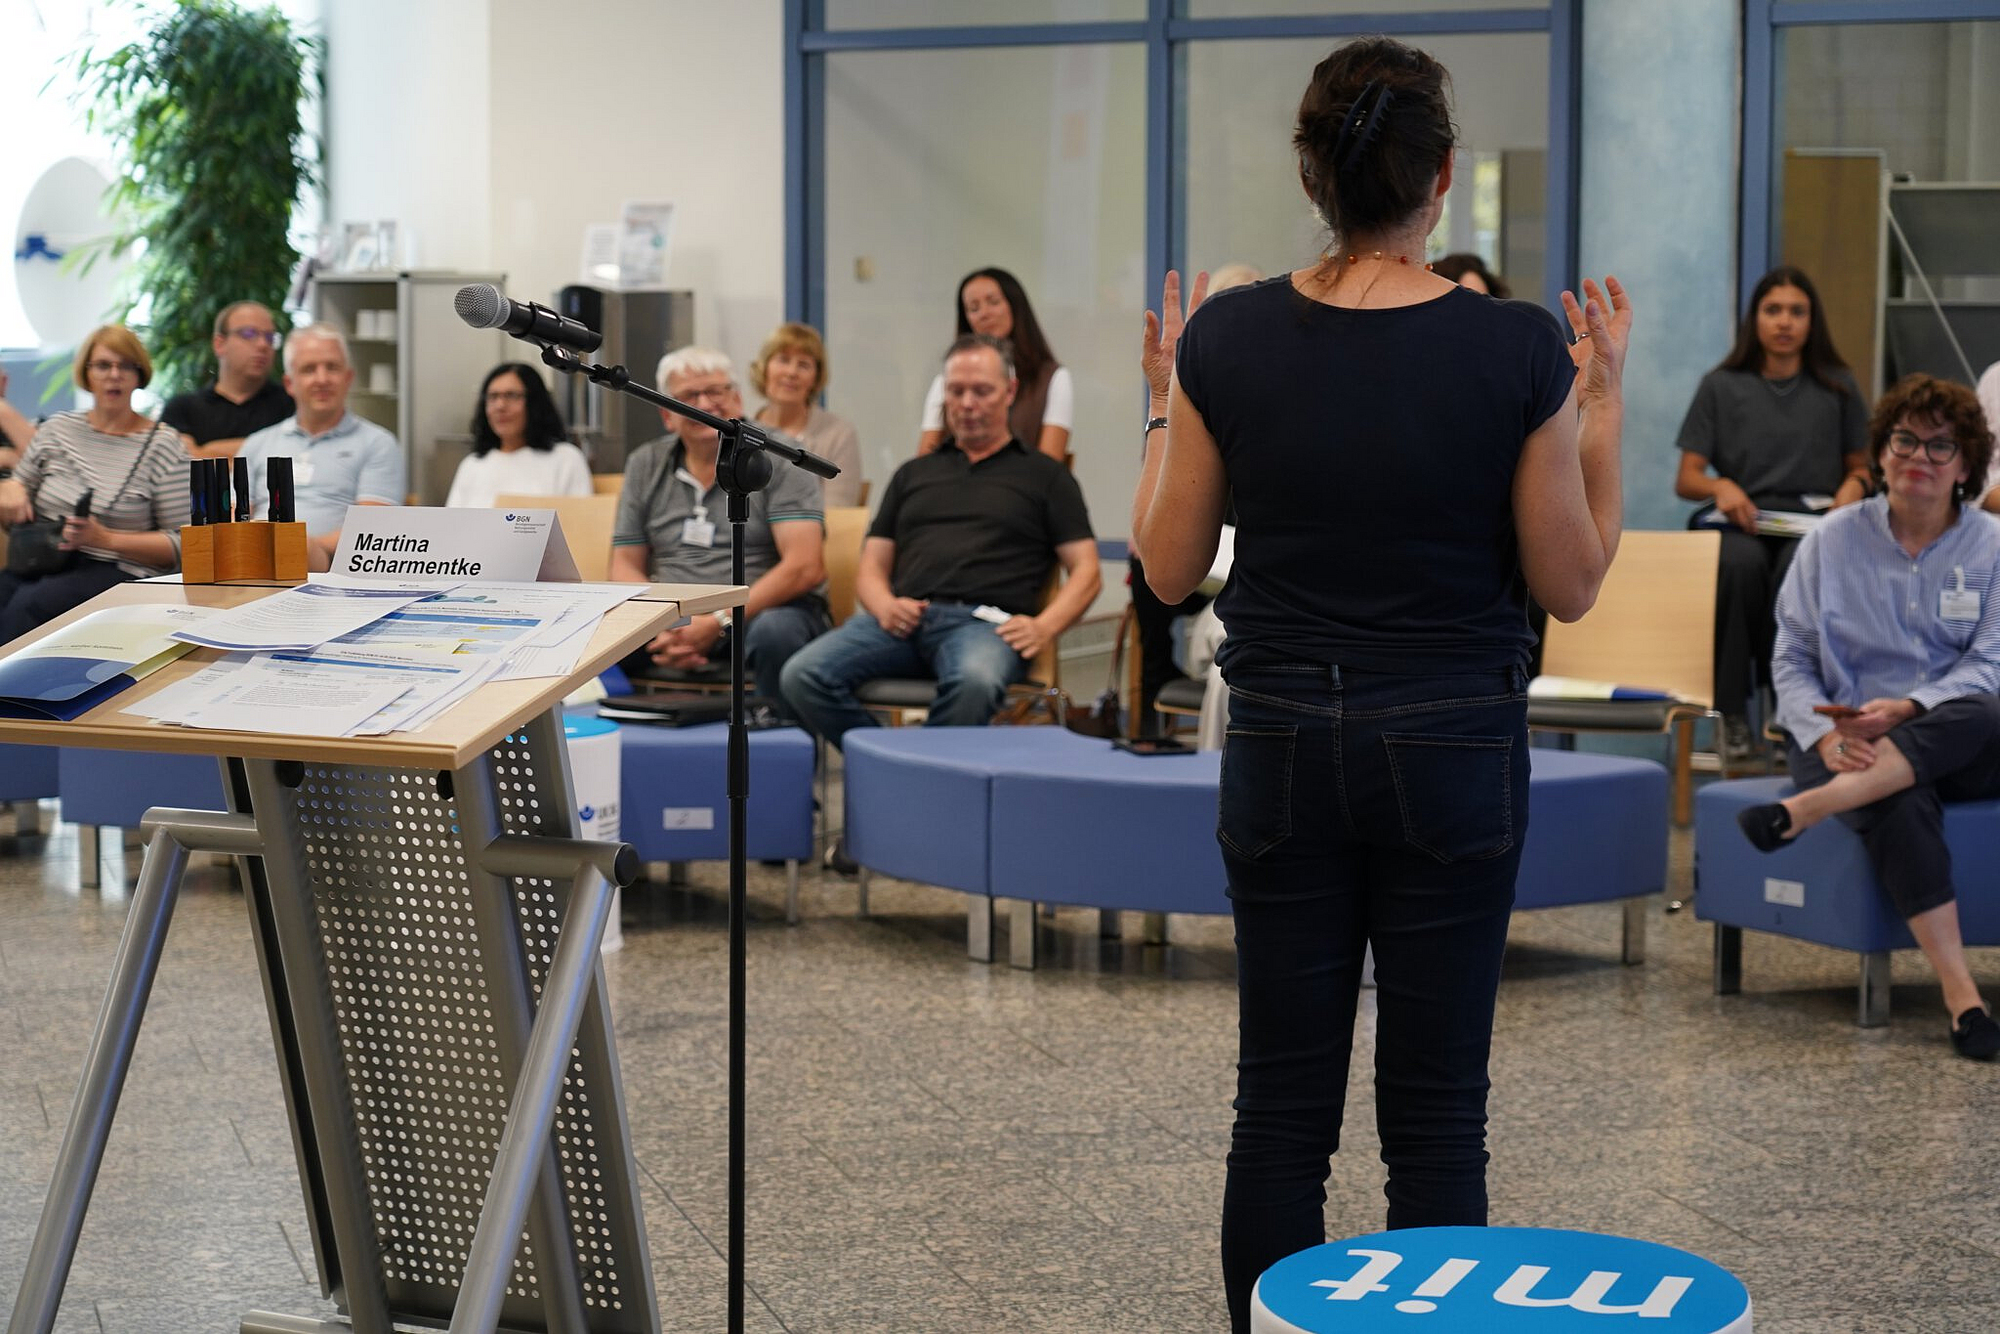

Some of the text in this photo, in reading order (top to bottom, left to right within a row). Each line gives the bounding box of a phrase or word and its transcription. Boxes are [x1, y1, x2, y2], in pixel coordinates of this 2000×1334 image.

[516, 515, 531, 523] BGN
[354, 533, 430, 552] Martina
[348, 554, 482, 576] Scharmentke
[1309, 1249, 1695, 1318] mit
